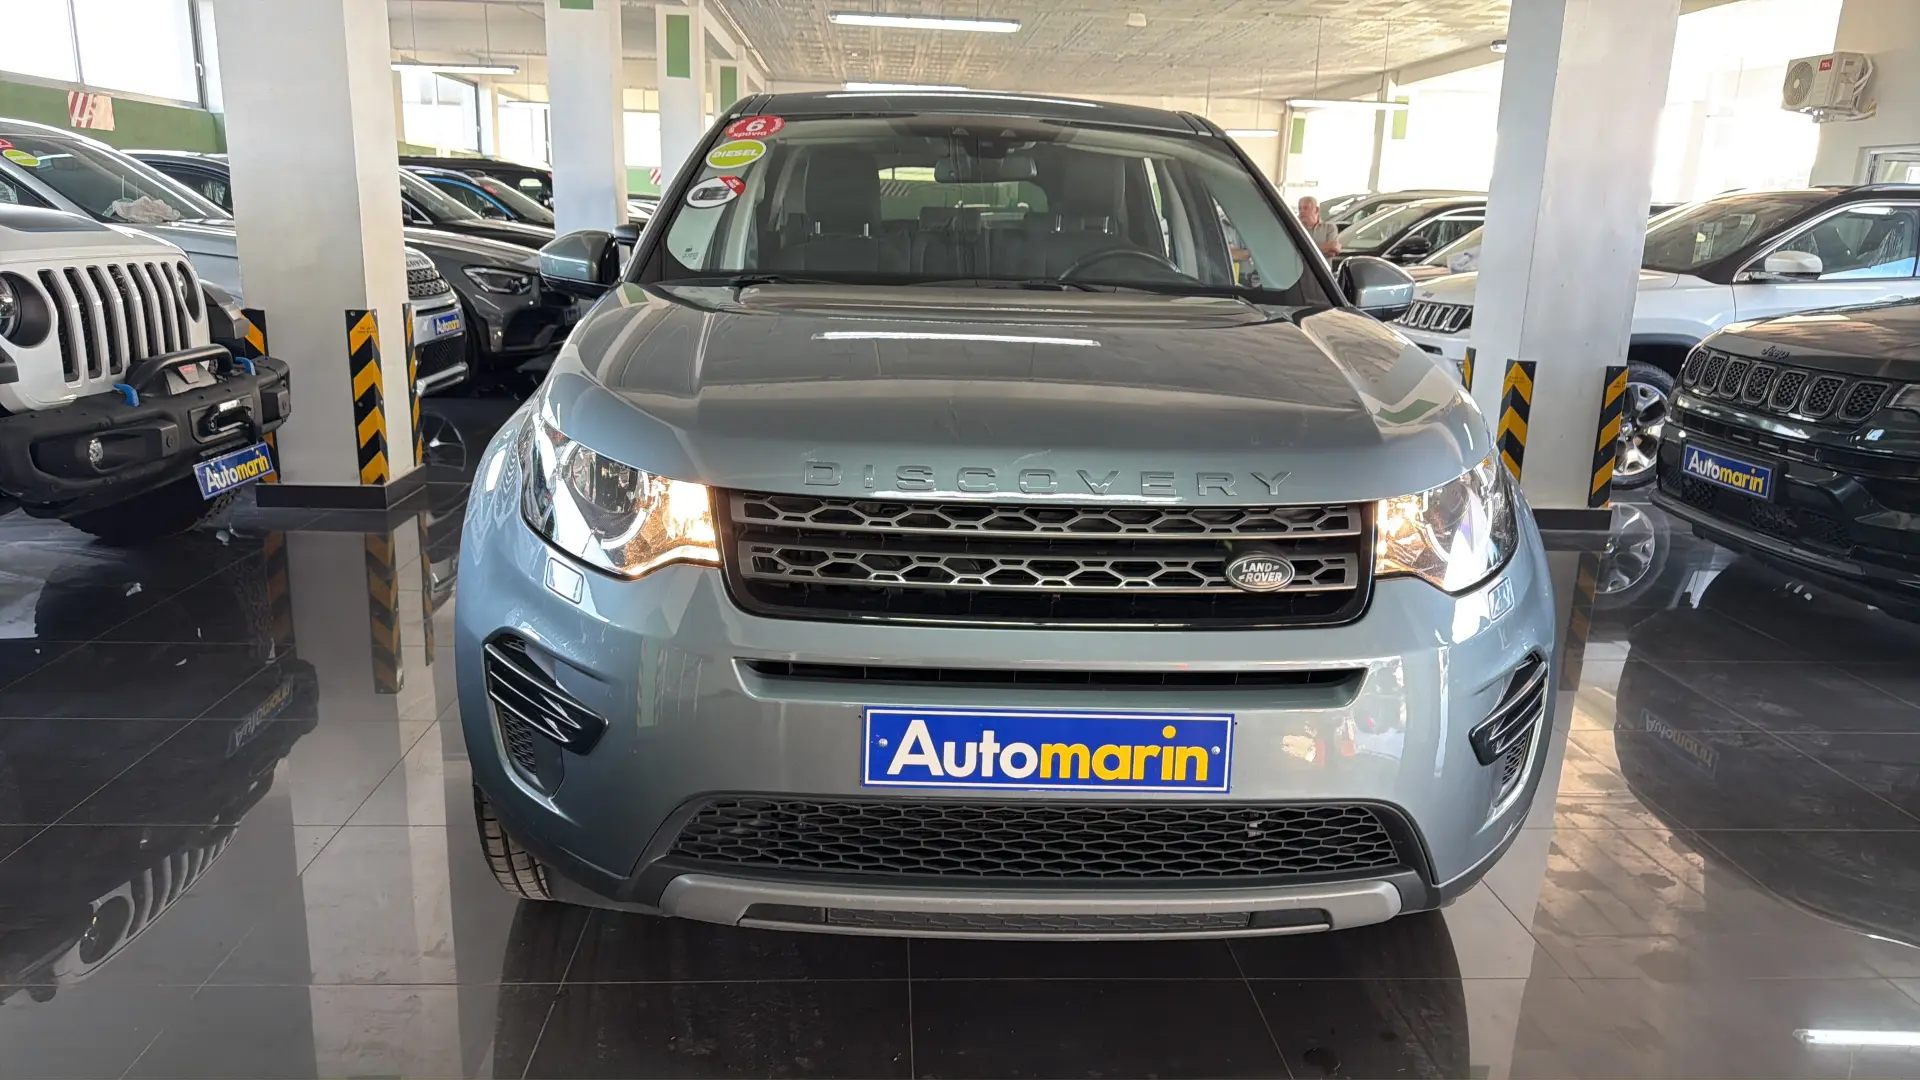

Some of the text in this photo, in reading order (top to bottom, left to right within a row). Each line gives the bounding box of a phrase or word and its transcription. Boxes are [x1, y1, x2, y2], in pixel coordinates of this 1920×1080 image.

[746, 118, 767, 132] 6
[711, 148, 759, 159] DIESEL
[205, 449, 270, 493] Automarin
[804, 460, 1291, 497] DISCOVERY
[1687, 450, 1765, 494] Automarin
[1242, 561, 1273, 573] LAND
[1245, 571, 1283, 583] ROVER
[887, 719, 1209, 781] Automarin
